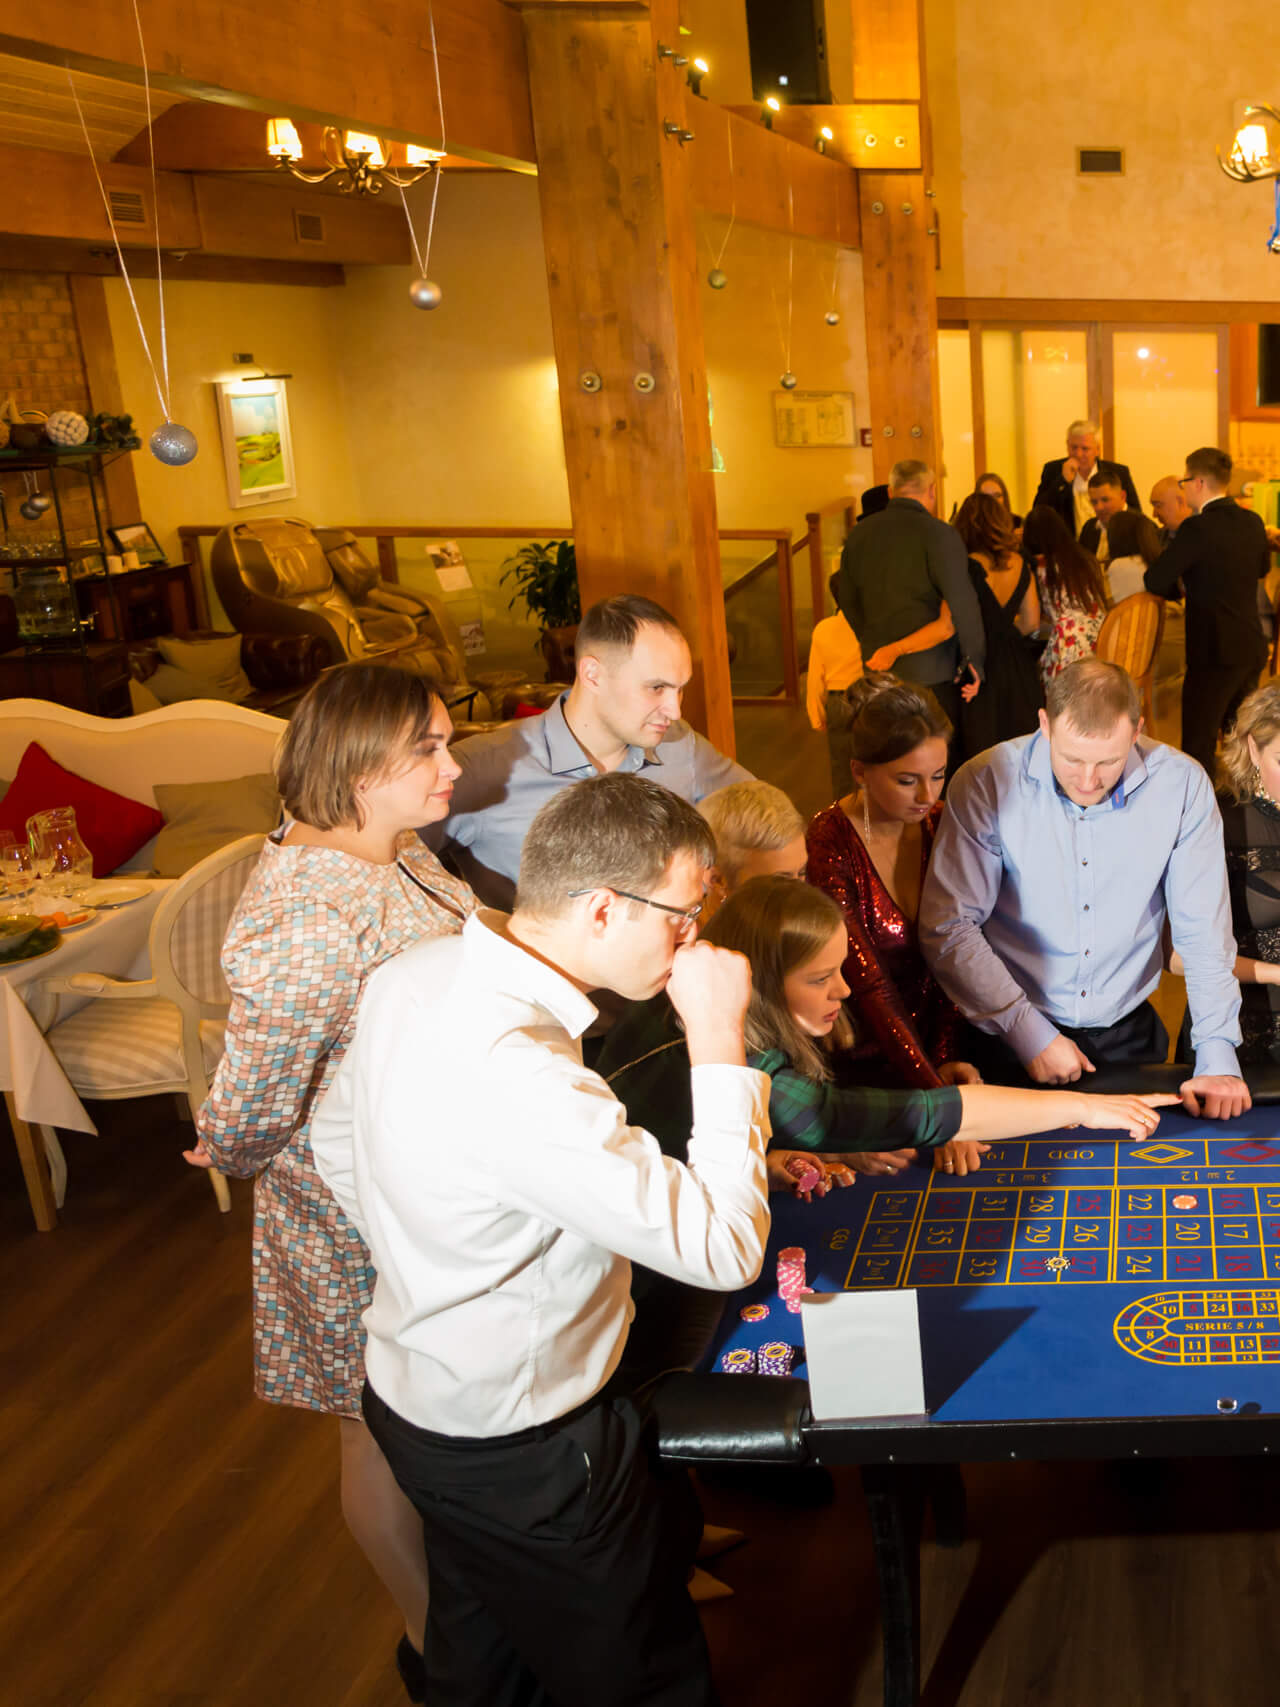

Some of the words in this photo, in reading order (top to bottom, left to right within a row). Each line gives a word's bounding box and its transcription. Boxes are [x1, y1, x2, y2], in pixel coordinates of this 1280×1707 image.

[1048, 1150, 1094, 1160] ODD
[996, 1173, 1015, 1183] 12
[1181, 1171, 1198, 1181] 12
[1225, 1171, 1236, 1180] 2
[982, 1197, 1007, 1212] 31
[1029, 1195, 1054, 1213] 28
[1076, 1195, 1101, 1212] 25
[1128, 1194, 1152, 1211] 22
[1220, 1193, 1246, 1209] 16
[928, 1227, 954, 1244] 35
[976, 1225, 1002, 1243] 32
[1025, 1225, 1051, 1243] 29
[1073, 1224, 1099, 1242] 26
[1127, 1224, 1152, 1241] 23
[1176, 1223, 1200, 1241] 20
[1224, 1223, 1248, 1239] 17
[969, 1258, 997, 1277] 33
[1020, 1256, 1047, 1276] 30
[1071, 1256, 1097, 1275] 27
[1126, 1255, 1152, 1274] 24
[1176, 1255, 1202, 1272] 21
[1224, 1256, 1252, 1272] 18
[1163, 1305, 1177, 1314] 10
[1210, 1304, 1226, 1313] 24
[1235, 1303, 1251, 1312] 16
[1260, 1302, 1275, 1312] 33
[1146, 1330, 1155, 1339] 8
[1185, 1323, 1232, 1331] SERIE
[1188, 1341, 1201, 1350] 11
[1240, 1340, 1254, 1349] 13
[1264, 1338, 1279, 1348] 27
